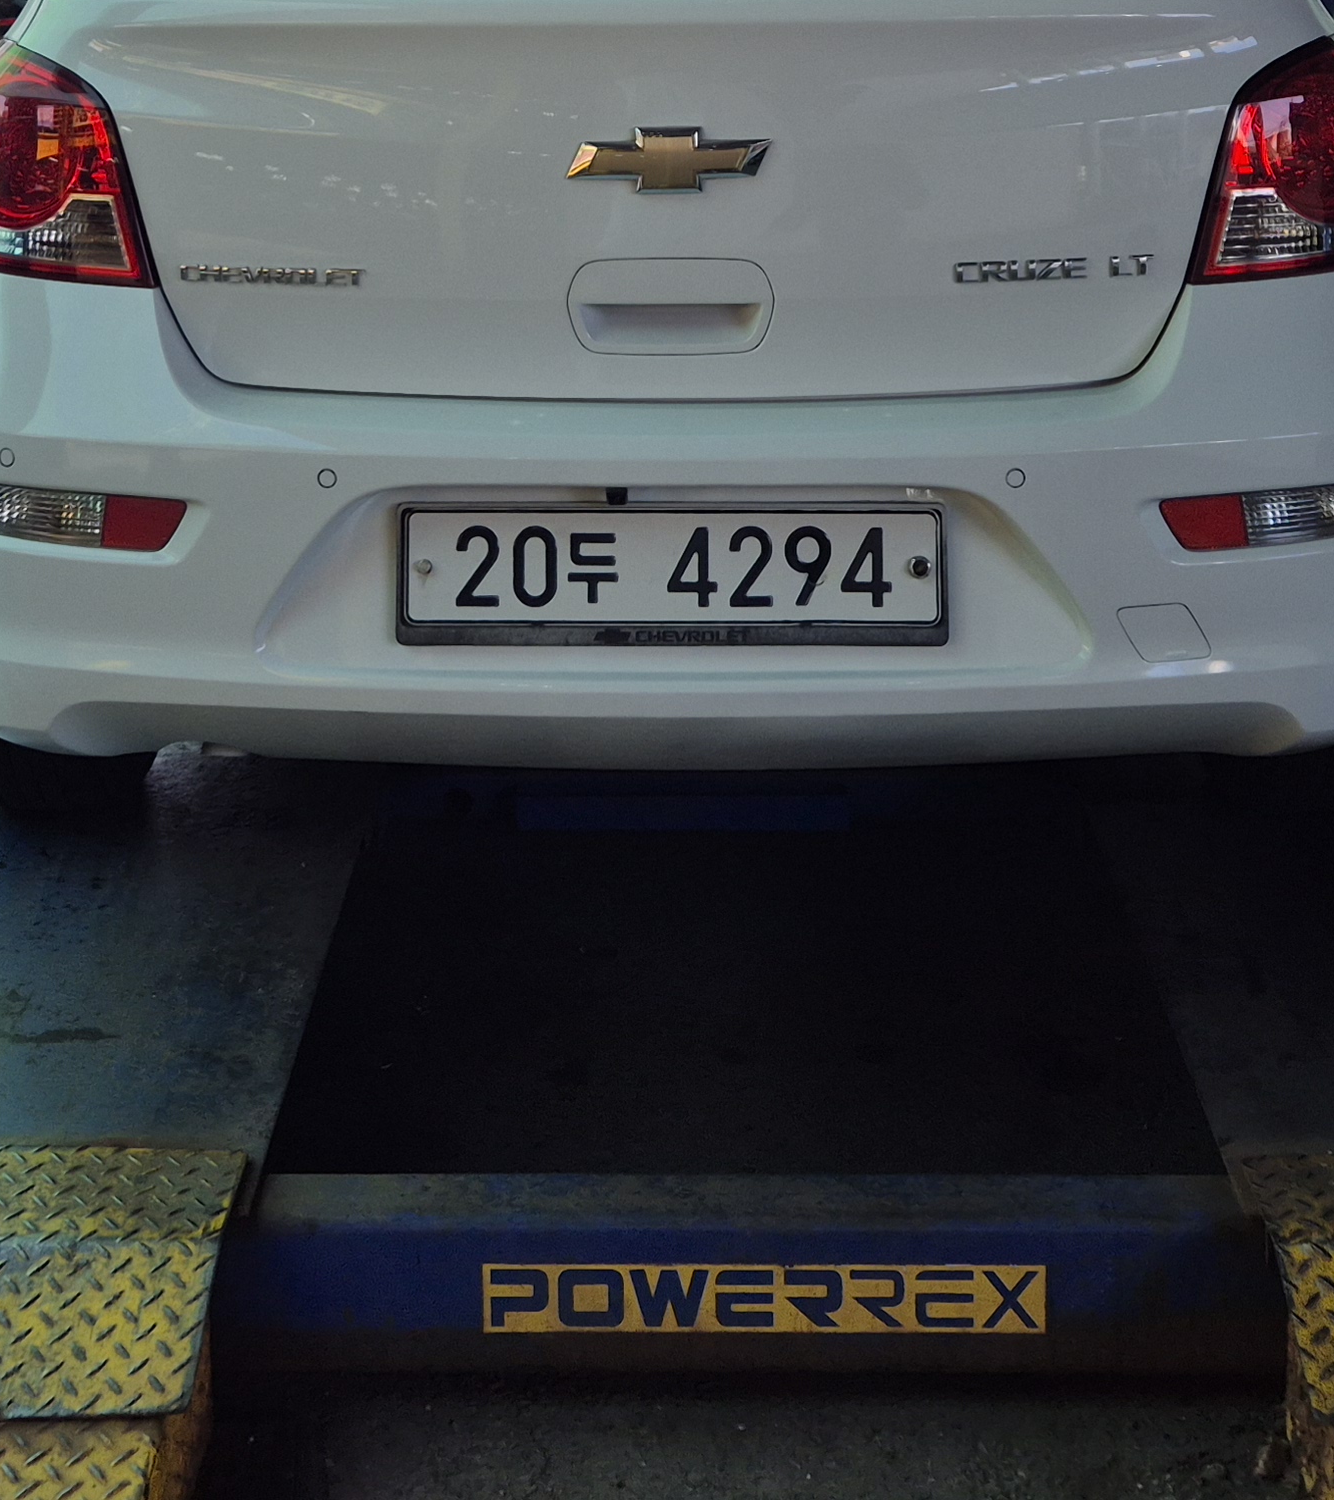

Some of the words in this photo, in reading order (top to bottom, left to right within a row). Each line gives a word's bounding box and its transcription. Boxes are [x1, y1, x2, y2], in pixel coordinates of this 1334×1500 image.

[180, 263, 366, 287] CHEVROLET
[954, 257, 1088, 284] CRUZE
[1109, 254, 1155, 279] LT
[455, 524, 619, 608] 20두
[666, 525, 893, 608] 4294
[635, 628, 749, 644] CHEVROLET
[489, 1267, 1039, 1329] POWERREX
